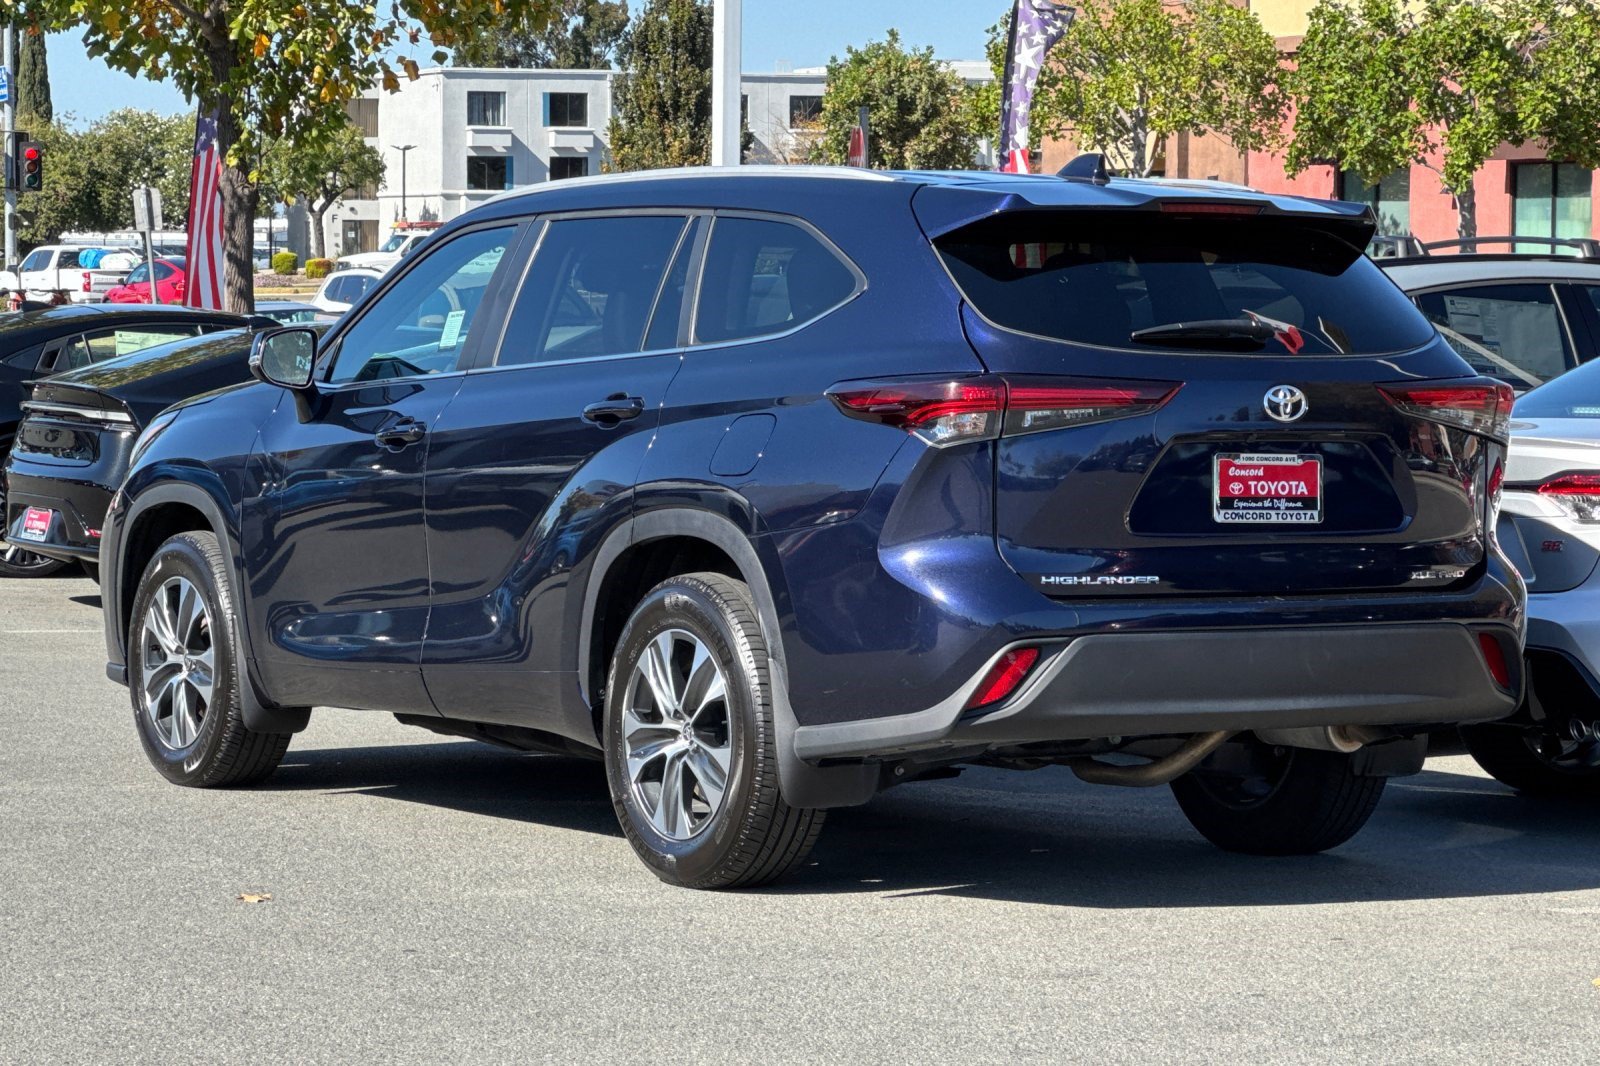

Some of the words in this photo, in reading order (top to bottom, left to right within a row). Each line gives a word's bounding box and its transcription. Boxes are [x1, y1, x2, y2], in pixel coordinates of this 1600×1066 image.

[1229, 467, 1264, 476] Concord
[1248, 481, 1308, 495] TOYOTA
[1234, 499, 1262, 509] Experience
[1263, 498, 1272, 507] the
[1223, 512, 1272, 520] CONCORD
[1275, 512, 1315, 520] TOYOTA
[1411, 571, 1436, 579] XLE
[1438, 570, 1465, 578] AWD
[1041, 576, 1160, 584] HIGHLANDER
